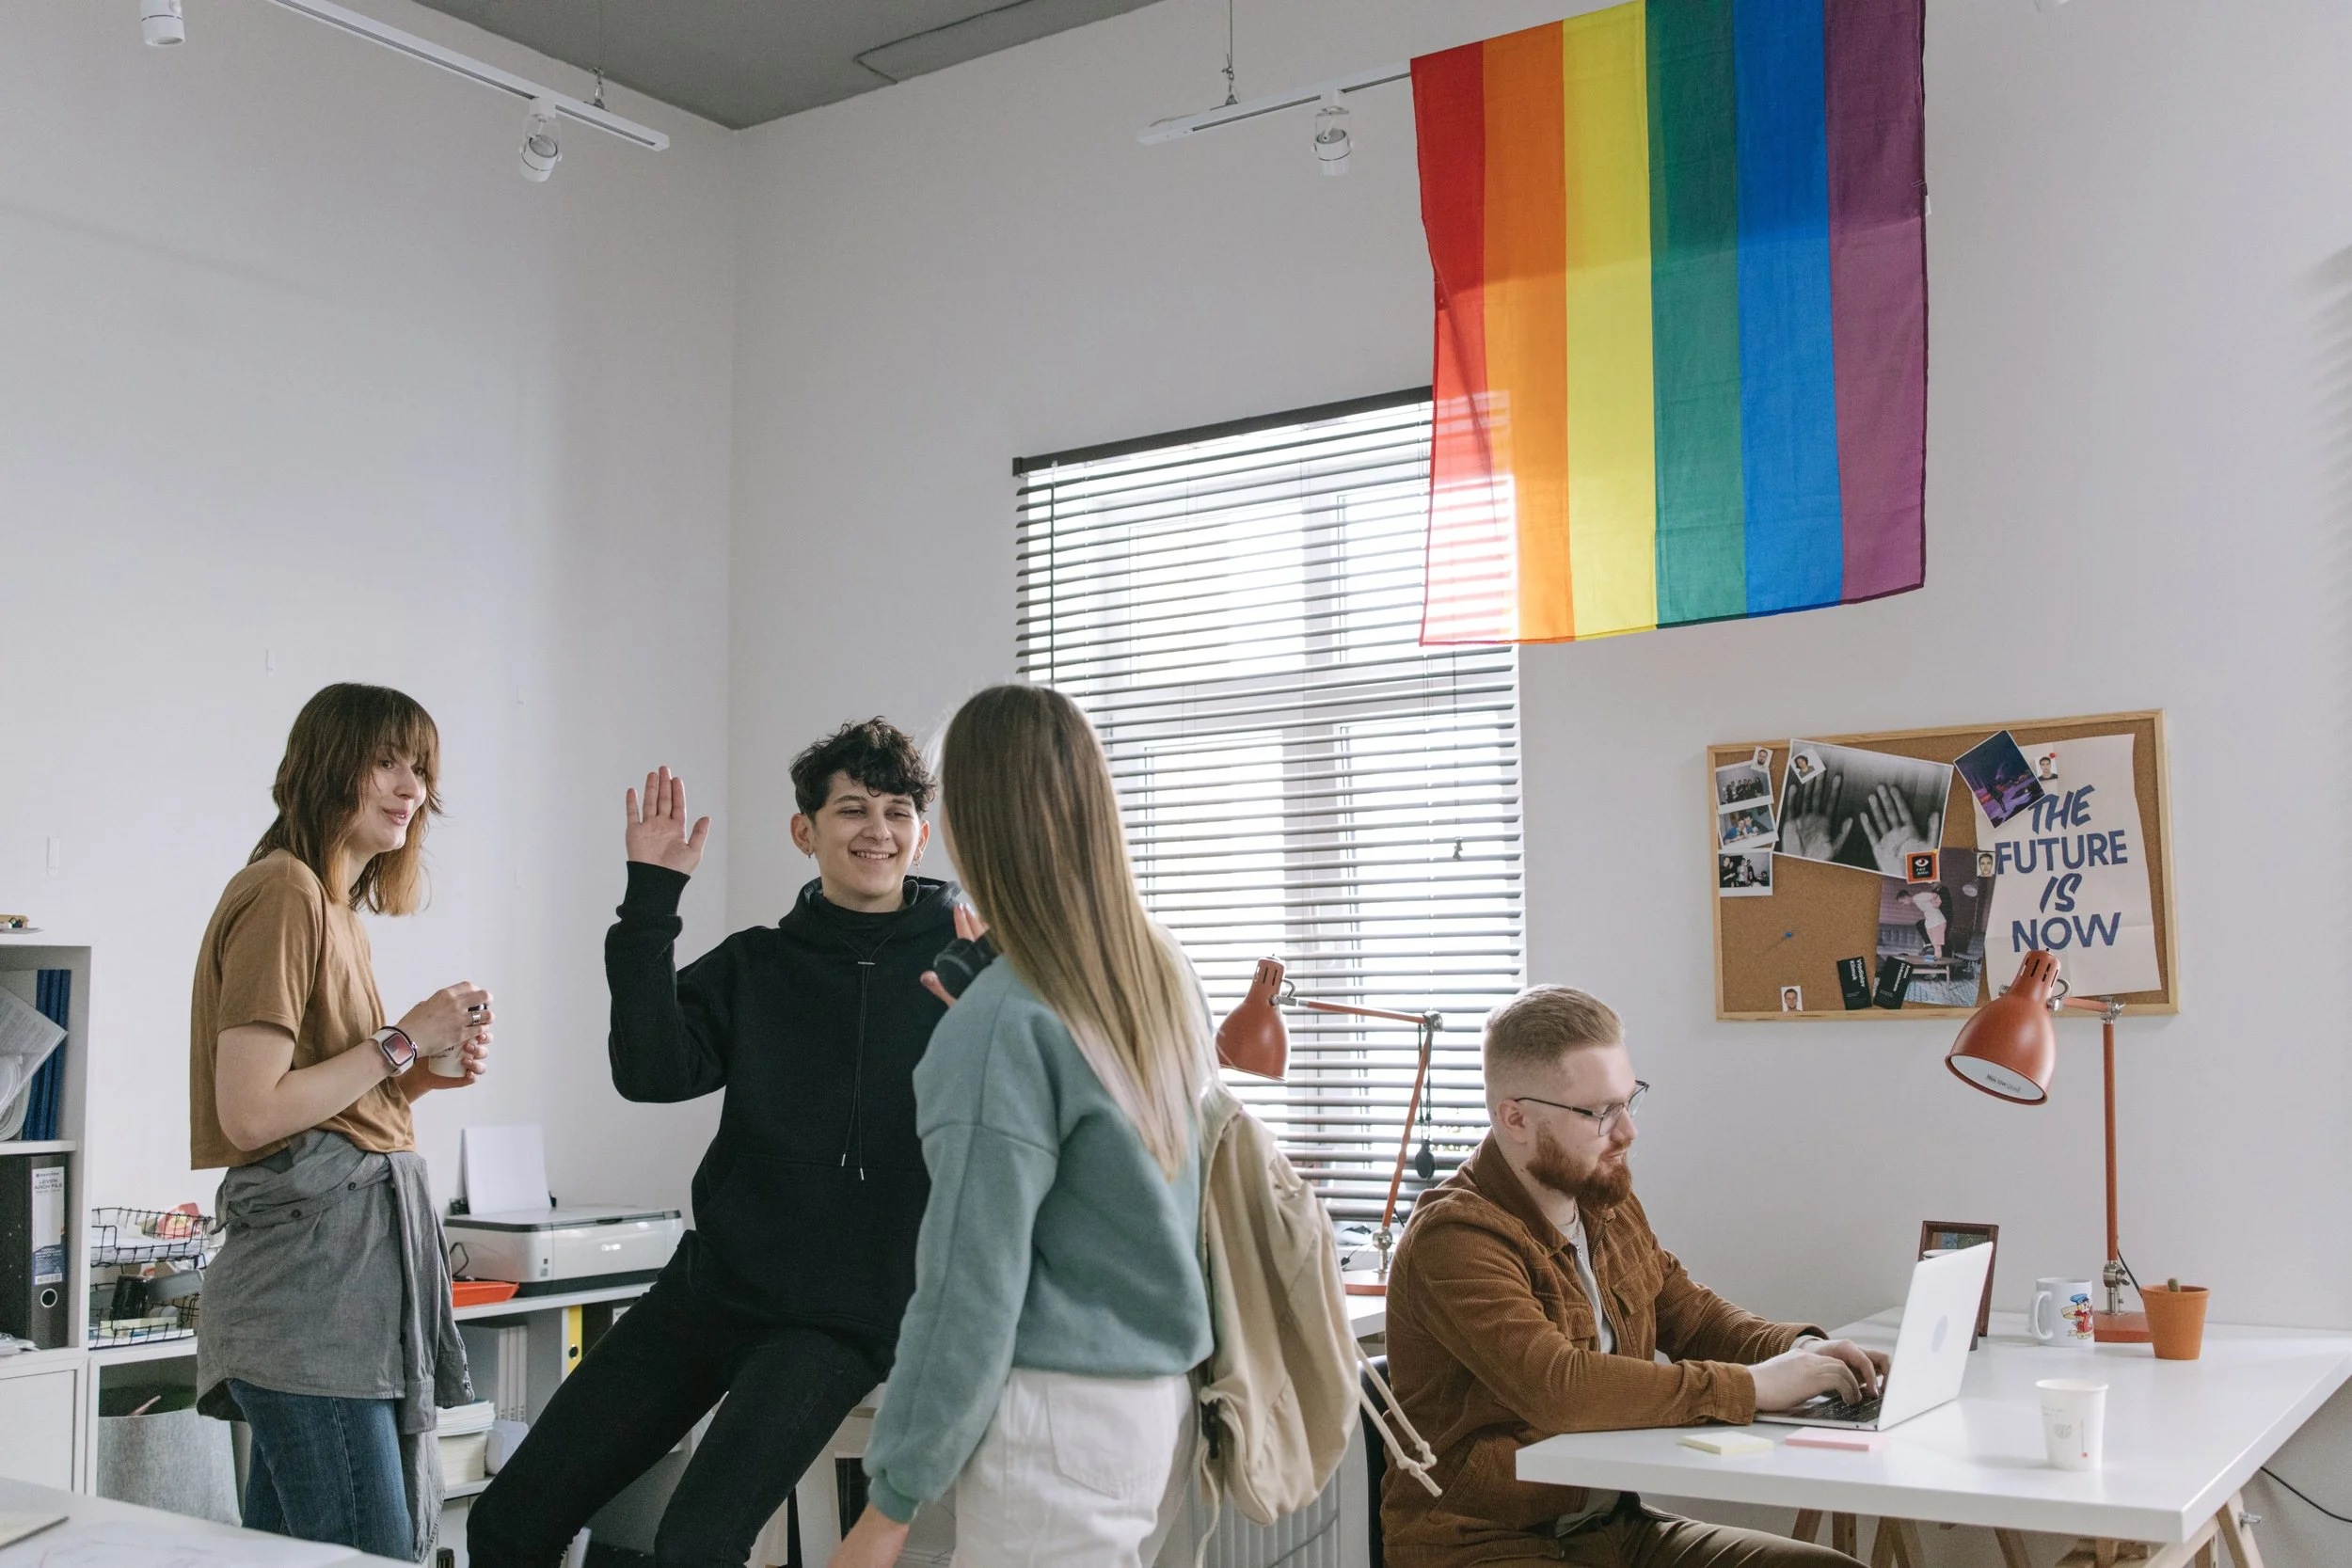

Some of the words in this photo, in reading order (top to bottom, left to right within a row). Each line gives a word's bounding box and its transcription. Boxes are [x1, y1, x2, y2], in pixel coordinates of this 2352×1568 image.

[2027, 784, 2096, 835] THE
[1994, 830, 2128, 875] FUTURE
[2039, 873, 2083, 913] IS
[2012, 911, 2122, 953] NOW
